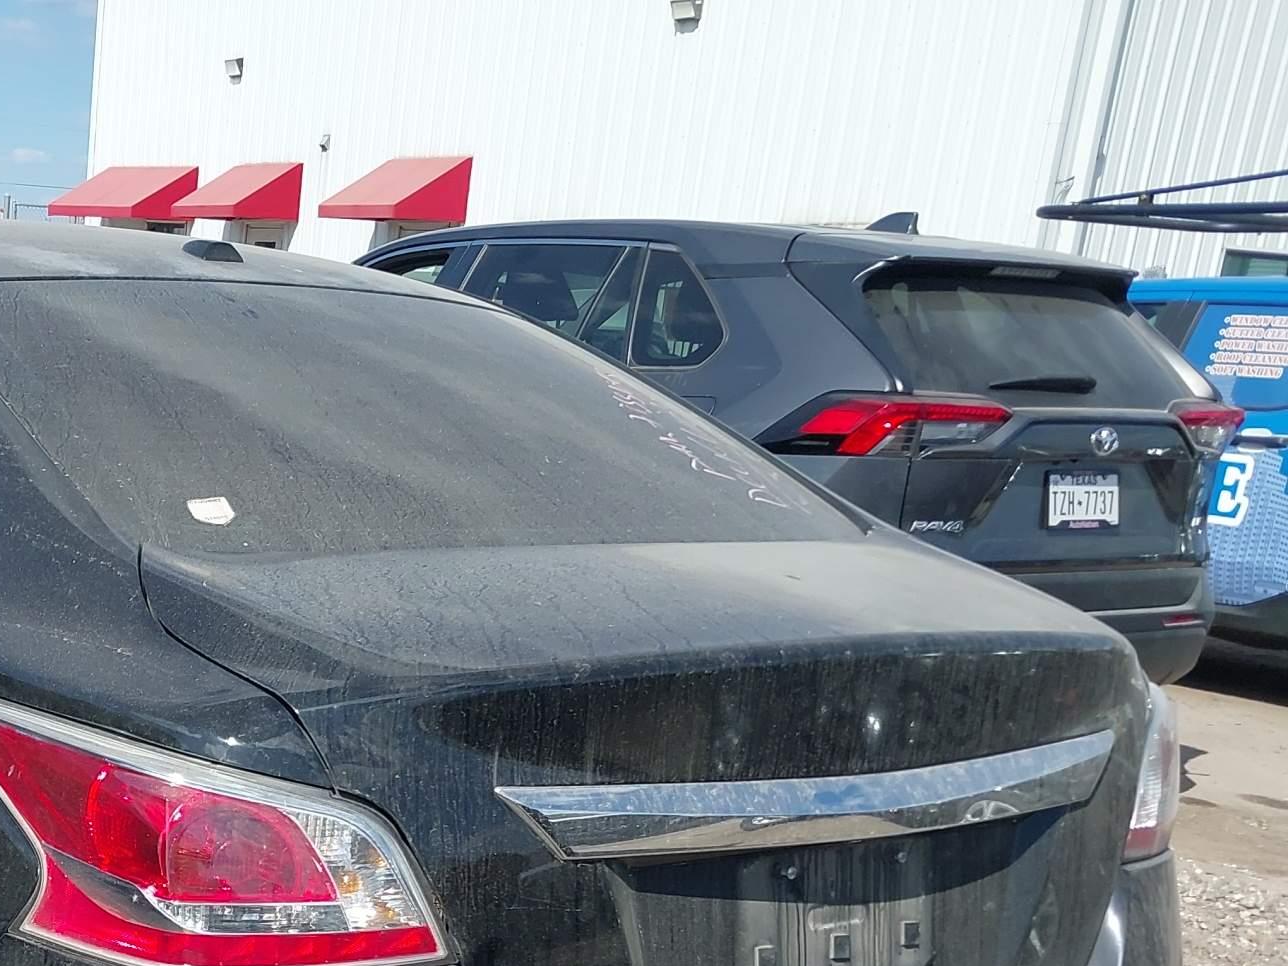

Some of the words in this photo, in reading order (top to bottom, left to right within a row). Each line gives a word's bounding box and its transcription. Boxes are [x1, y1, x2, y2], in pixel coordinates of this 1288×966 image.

[1231, 315, 1272, 326] WINDOW
[1225, 328, 1263, 338] GUTTER
[1220, 340, 1255, 350] POWER
[1215, 352, 1242, 363] ROOF
[1210, 364, 1236, 375] SOFT
[1237, 366, 1283, 378] WASHING
[1072, 474, 1097, 486] TEXAS
